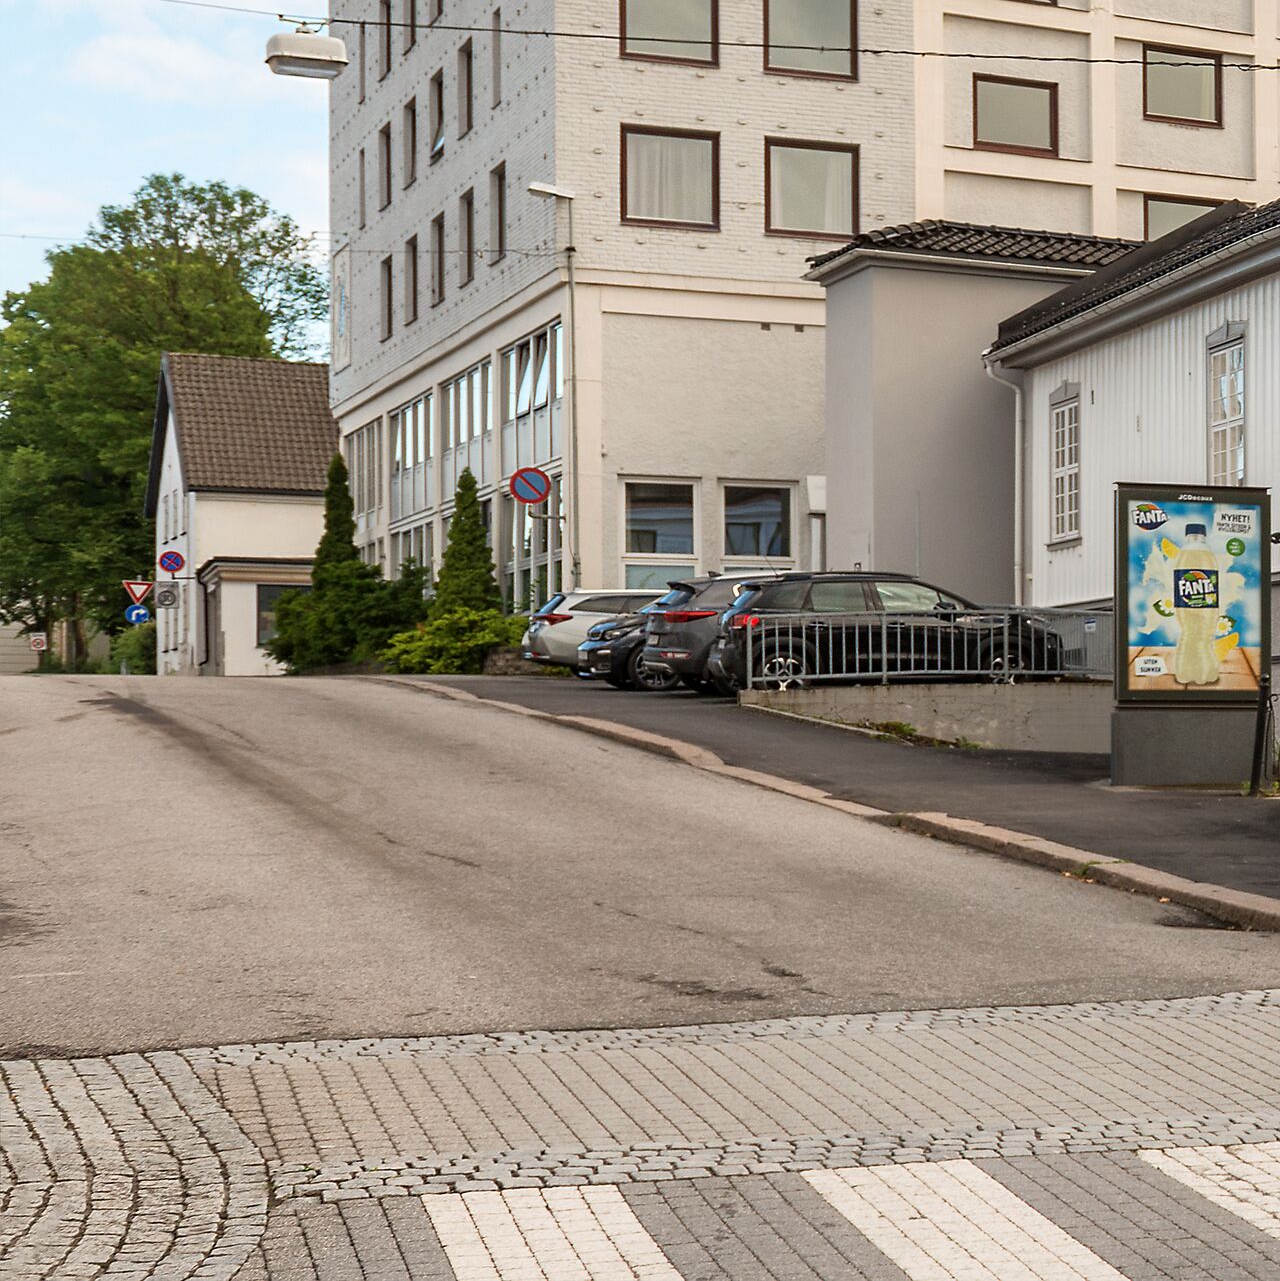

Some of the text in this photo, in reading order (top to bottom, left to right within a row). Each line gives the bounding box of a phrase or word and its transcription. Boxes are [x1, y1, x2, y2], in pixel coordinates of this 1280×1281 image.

[1132, 509, 1168, 524] FANTA
[1221, 513, 1250, 524] NYHET!
[1178, 578, 1215, 596] FANTA
